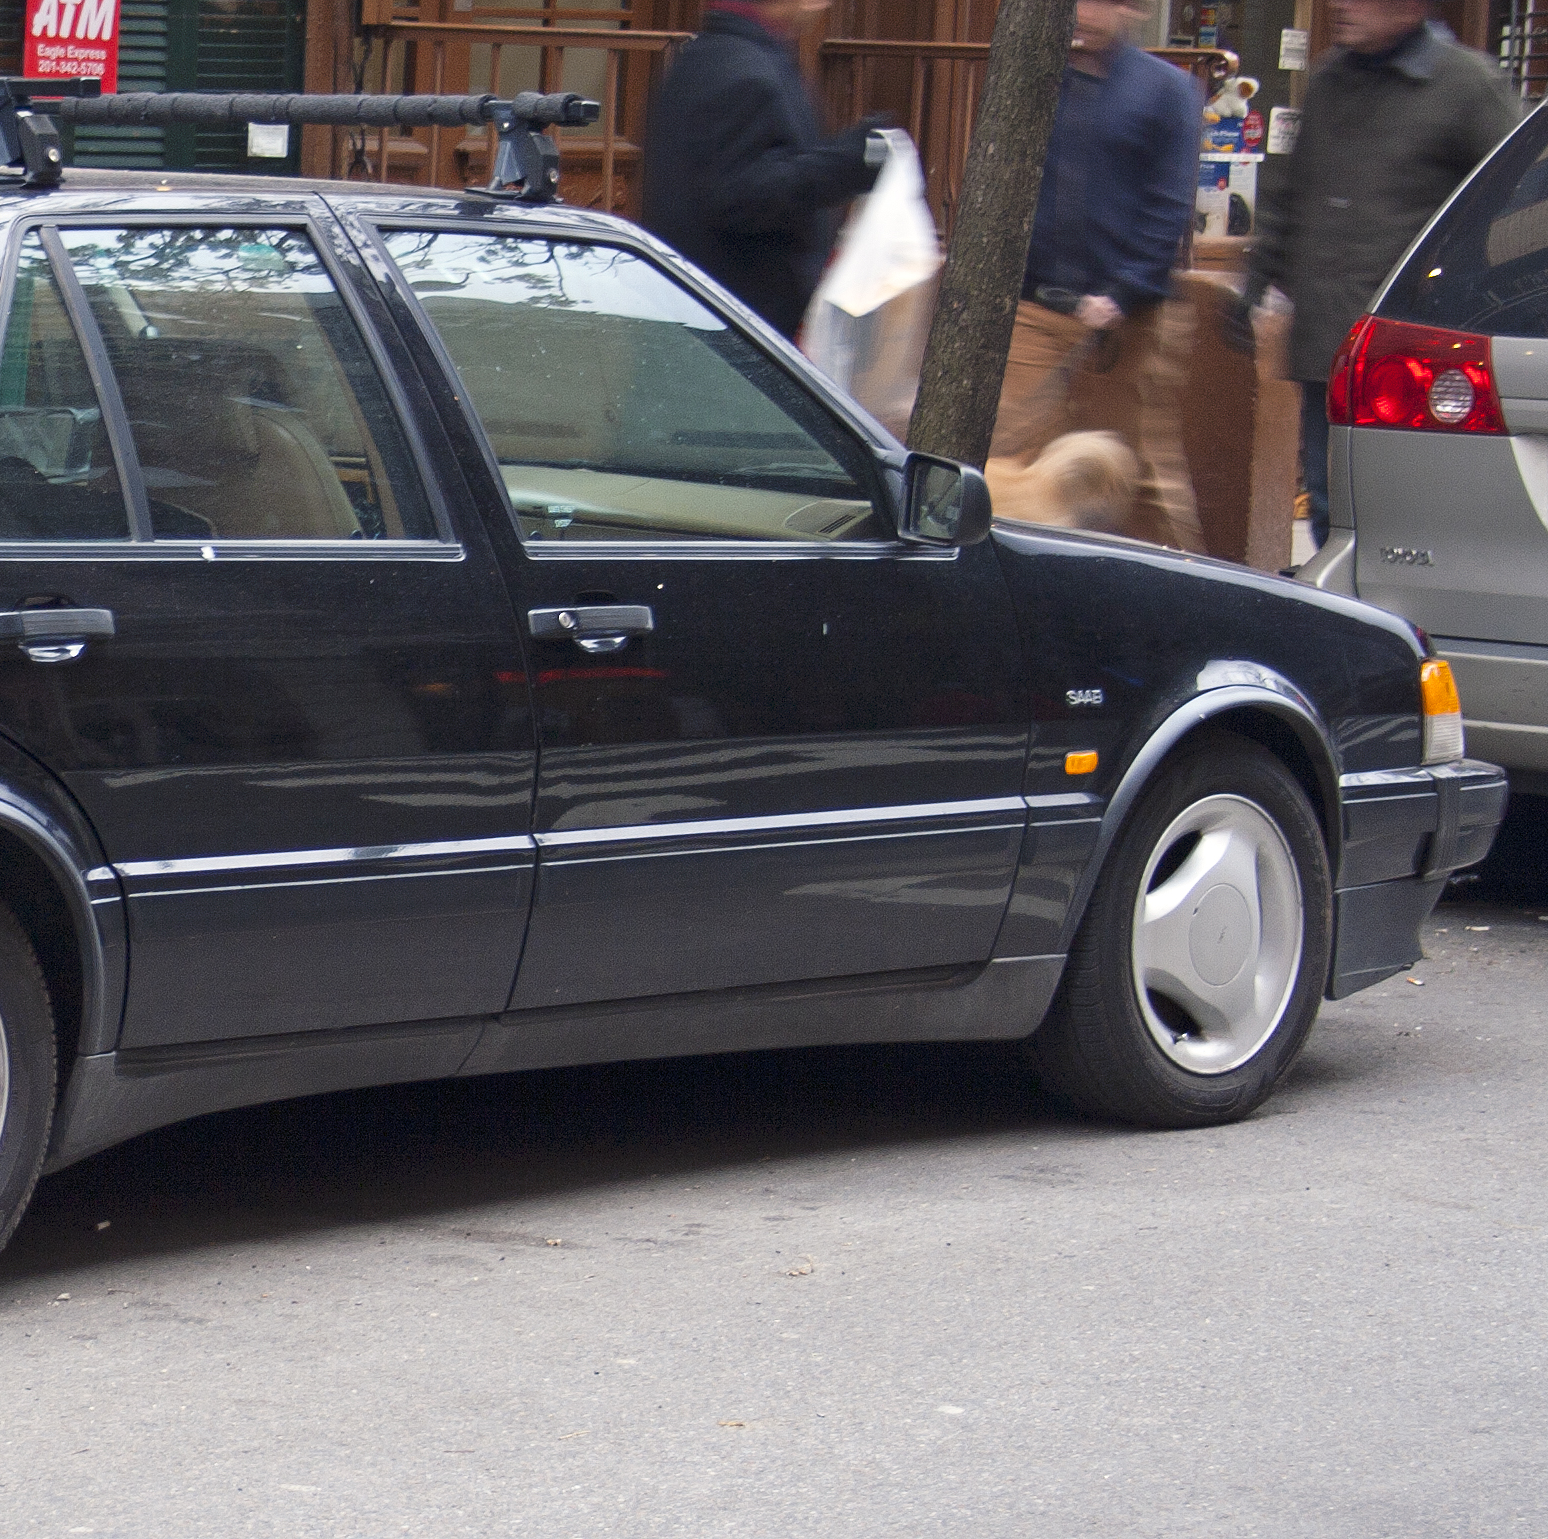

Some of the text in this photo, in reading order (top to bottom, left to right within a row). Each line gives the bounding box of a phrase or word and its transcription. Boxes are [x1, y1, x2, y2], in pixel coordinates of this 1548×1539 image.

[32, 0, 116, 41] ATM
[37, 44, 107, 61] Eagle Express
[1065, 689, 1103, 705] SAAB
